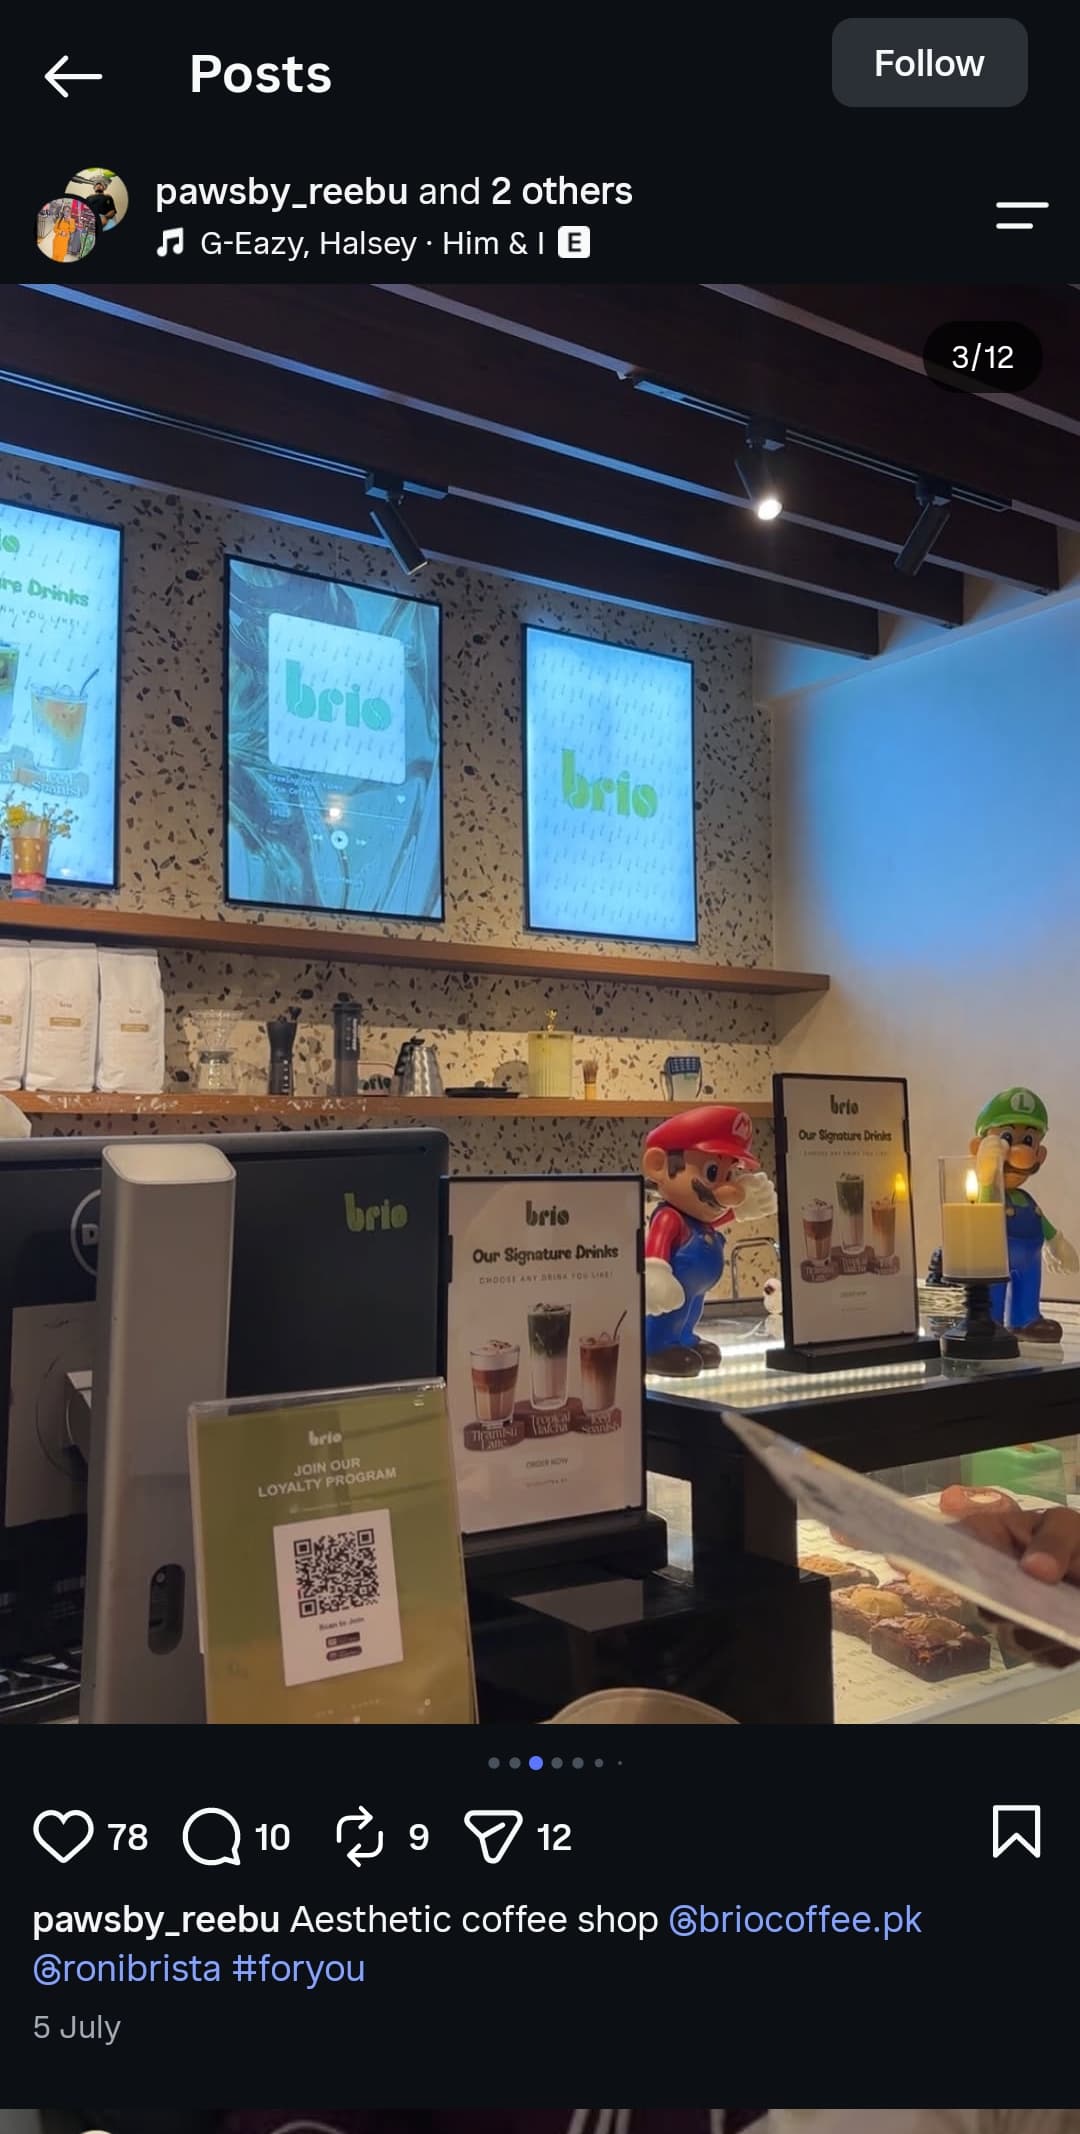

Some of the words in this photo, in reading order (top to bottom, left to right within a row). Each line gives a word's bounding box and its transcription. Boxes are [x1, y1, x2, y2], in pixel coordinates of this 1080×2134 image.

[27, 579, 89, 607] Drinks
[285, 659, 392, 732] brio
[561, 747, 658, 818] brio
[829, 1093, 859, 1115] brio
[798, 1129, 817, 1140] Our
[818, 1128, 862, 1144] Signature
[863, 1130, 892, 1142] Drinks
[343, 1191, 409, 1232] brio
[526, 1199, 570, 1226] brio
[472, 1249, 500, 1264] Our
[504, 1246, 572, 1266] Signature
[575, 1244, 619, 1260] Drinks
[479, 1276, 517, 1285] CHOOSE
[519, 1274, 538, 1283] ANY
[541, 1272, 568, 1281] DRINK
[571, 1271, 589, 1280] YOU
[308, 1429, 342, 1446] brio
[293, 1462, 327, 1477] JOIN
[330, 1457, 361, 1472] OUR
[525, 1460, 549, 1469] ORDER
[550, 1457, 569, 1466] NOW
[258, 1478, 322, 1498] LOYALTY
[325, 1467, 397, 1488] PROGRAM
